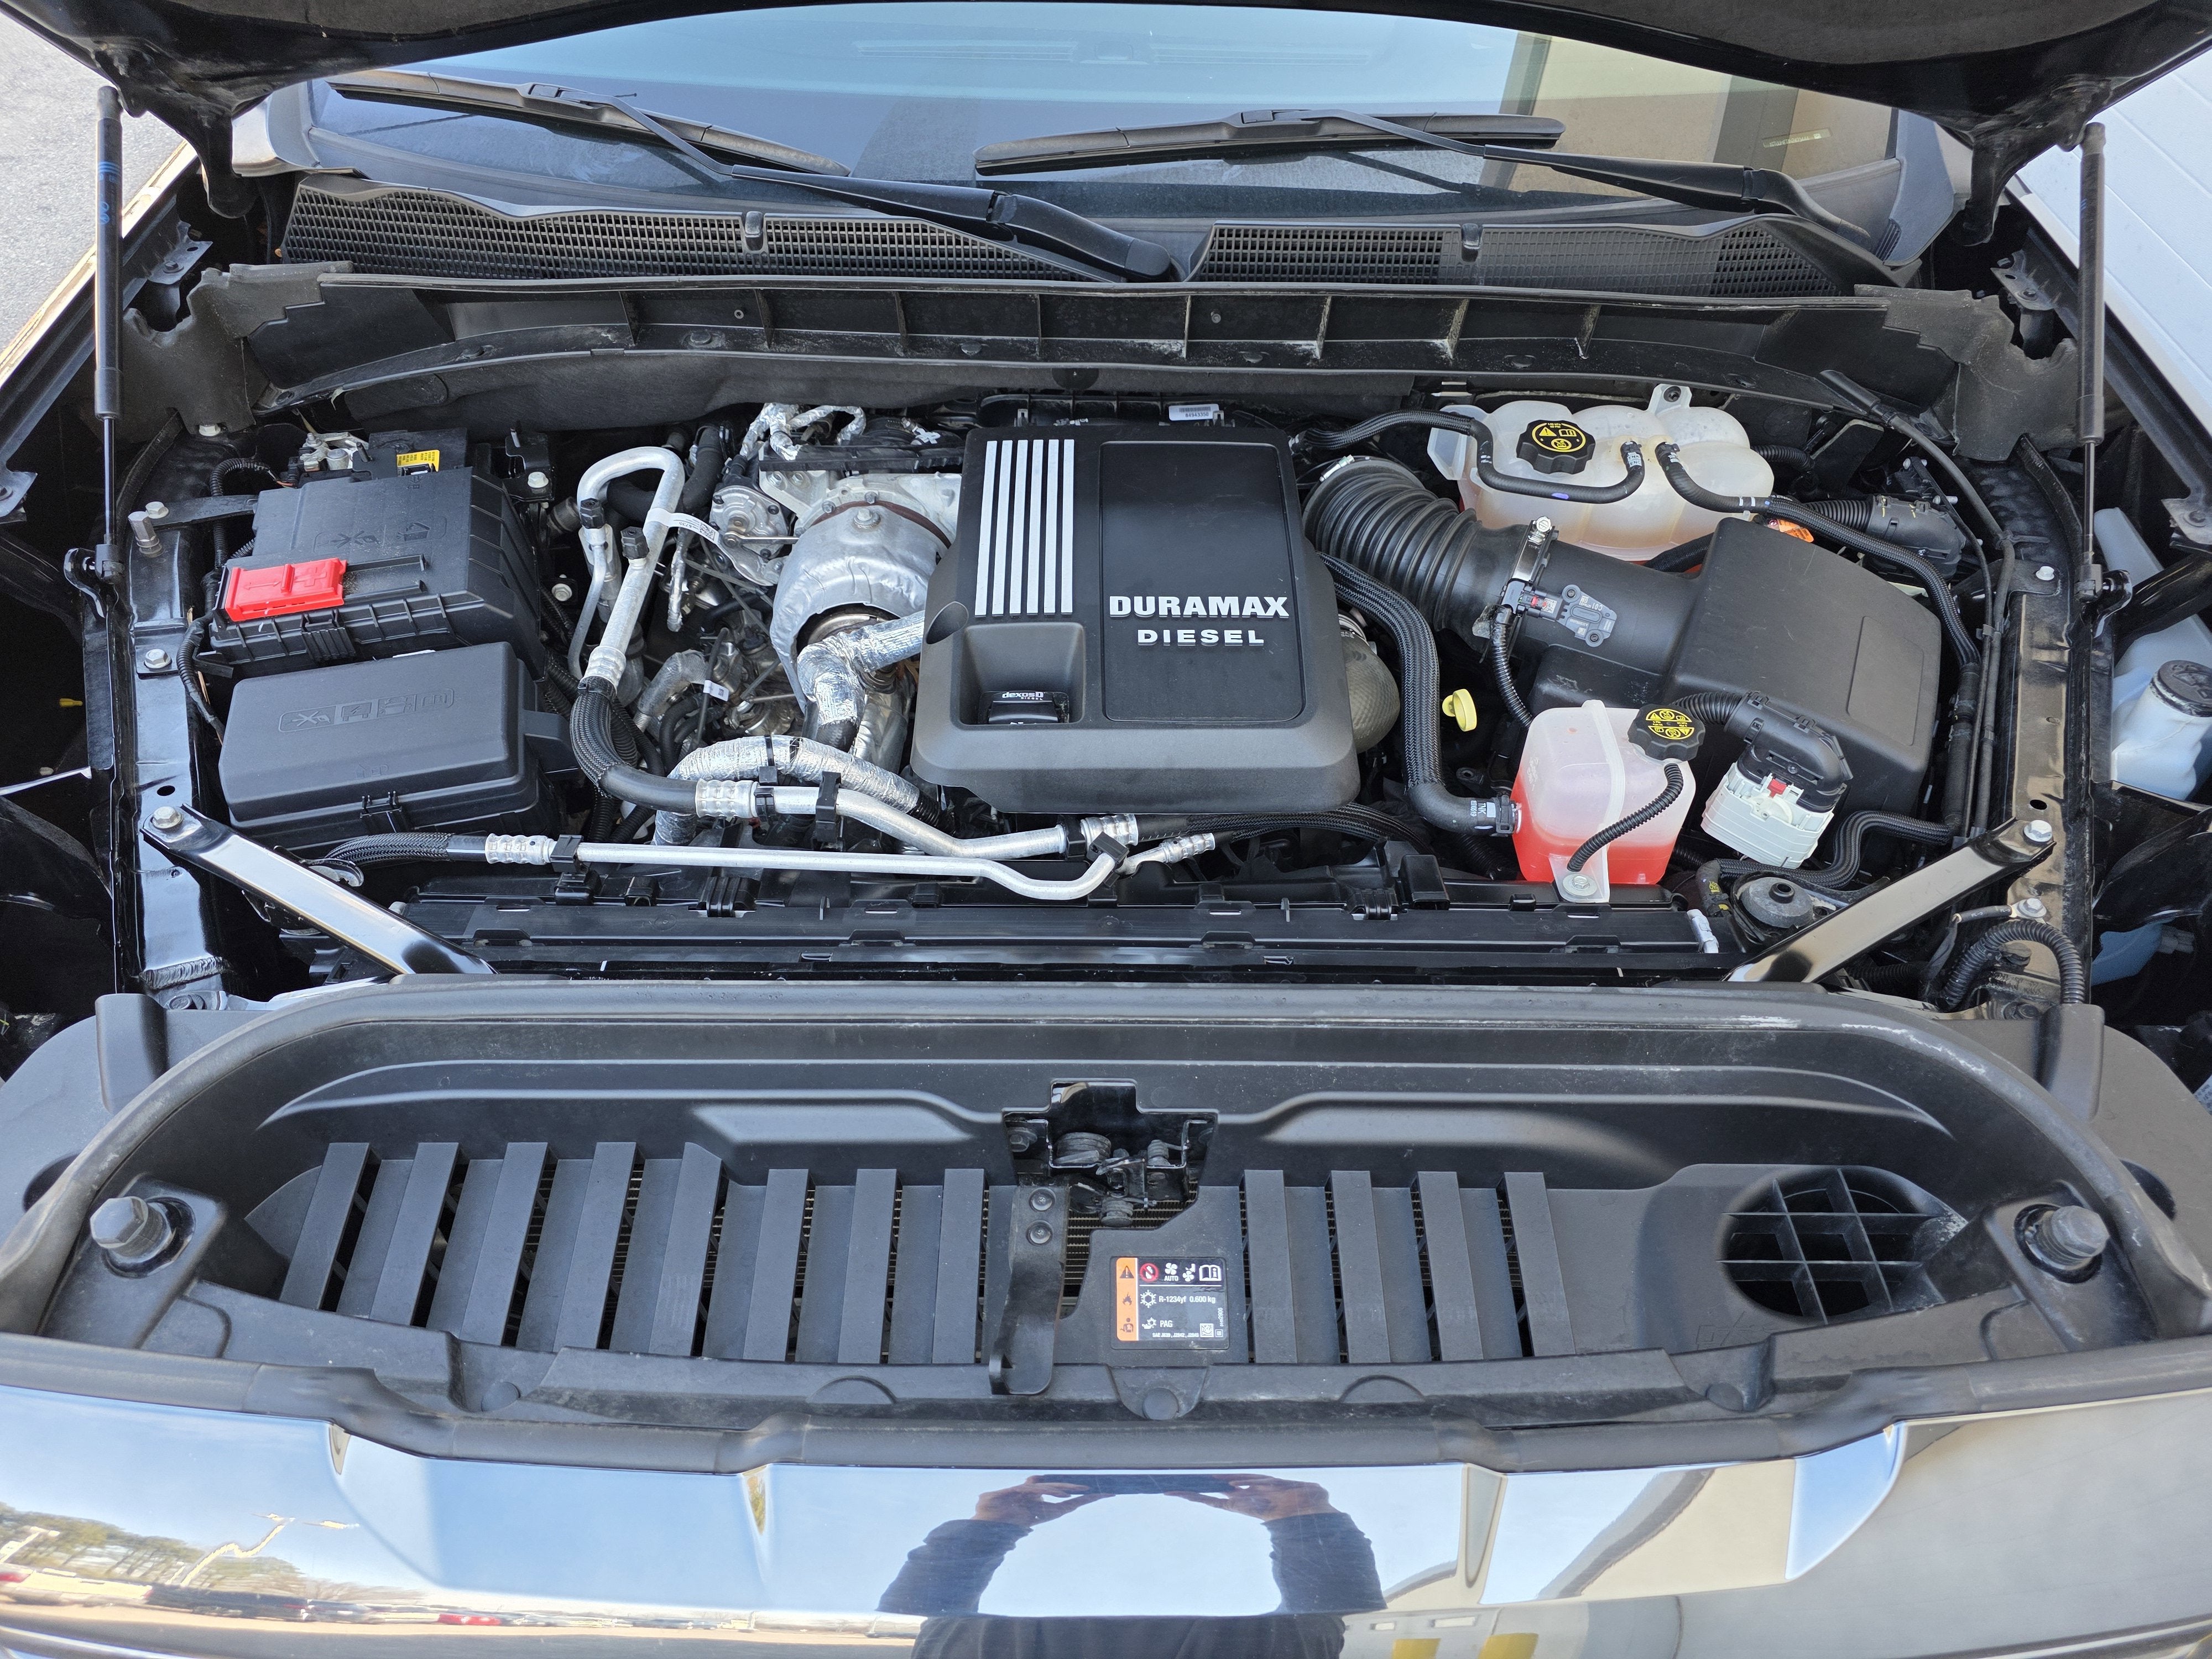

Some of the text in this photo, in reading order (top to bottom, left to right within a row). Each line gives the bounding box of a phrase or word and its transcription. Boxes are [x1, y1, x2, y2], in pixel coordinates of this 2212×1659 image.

[1109, 596, 1290, 618] DURAMAX
[1138, 629, 1264, 646] DIESEL
[1159, 1295, 1187, 1304] R-1234yf
[1207, 1296, 1216, 1304] kg
